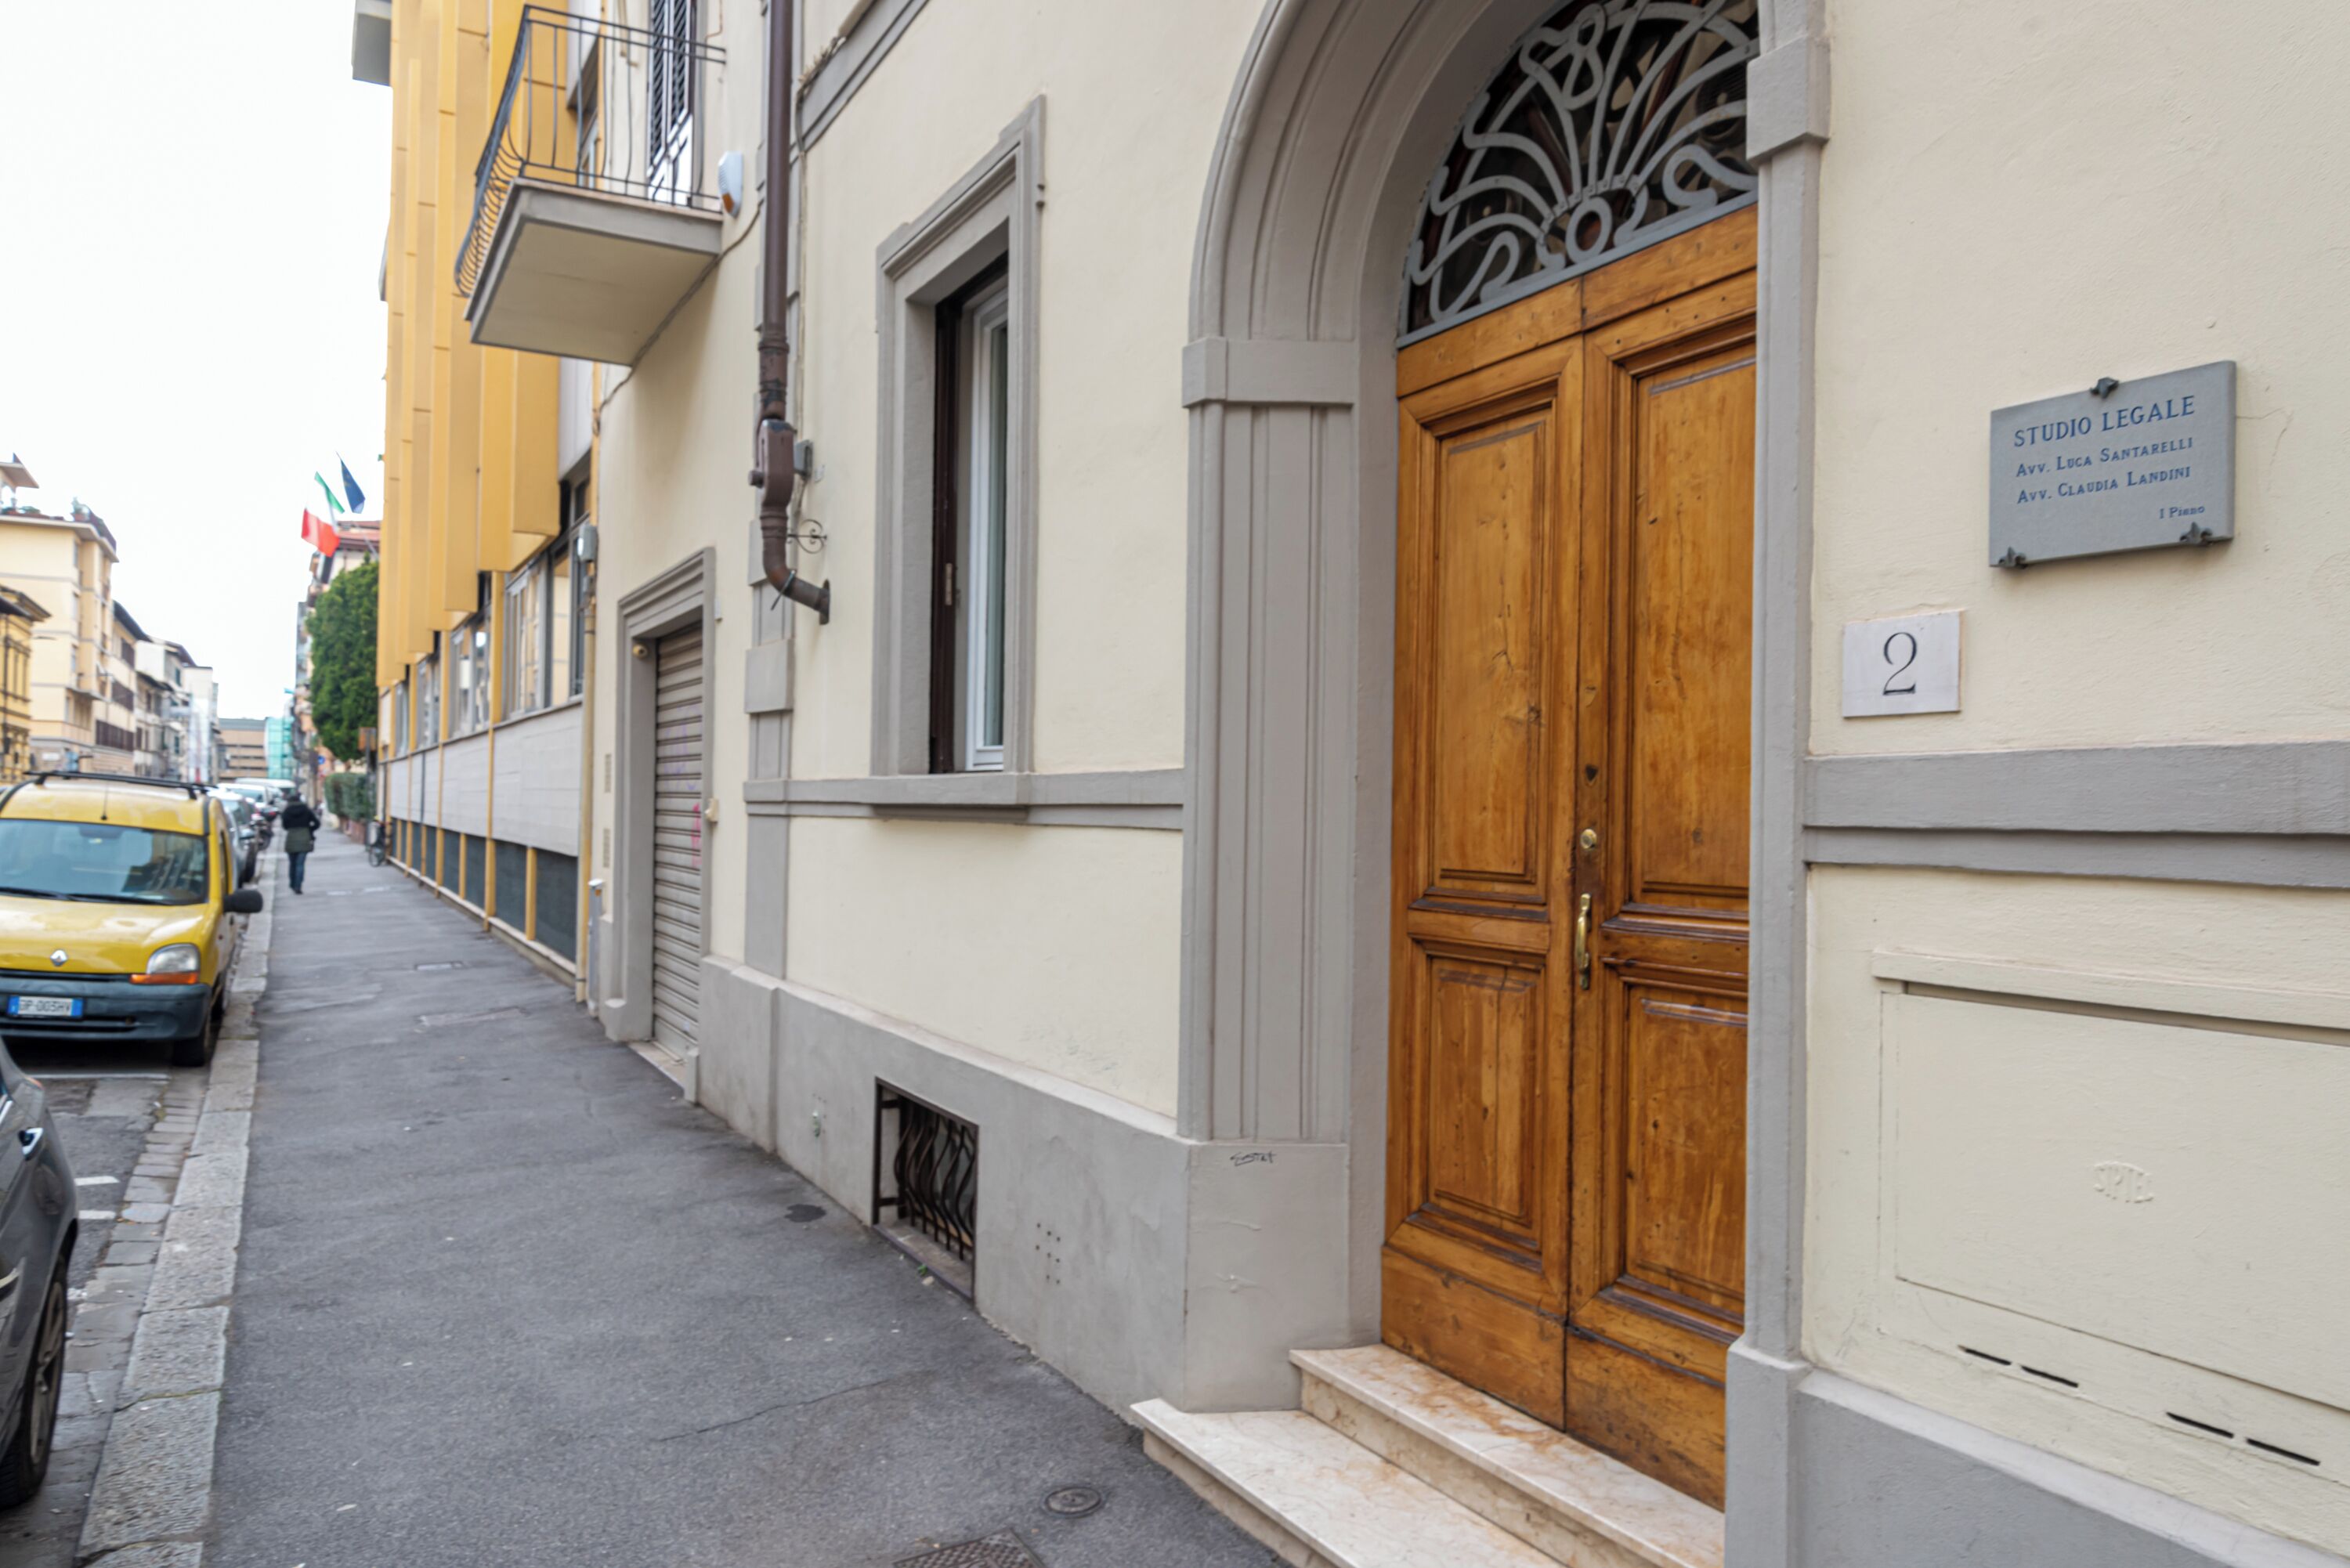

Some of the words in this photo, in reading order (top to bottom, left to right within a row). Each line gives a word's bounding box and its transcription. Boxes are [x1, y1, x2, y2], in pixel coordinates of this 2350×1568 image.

[2014, 417, 2092, 447] STUDIO
[2102, 396, 2195, 432] LEGALE
[2159, 508, 2164, 519] I
[1883, 631, 1918, 696] 2
